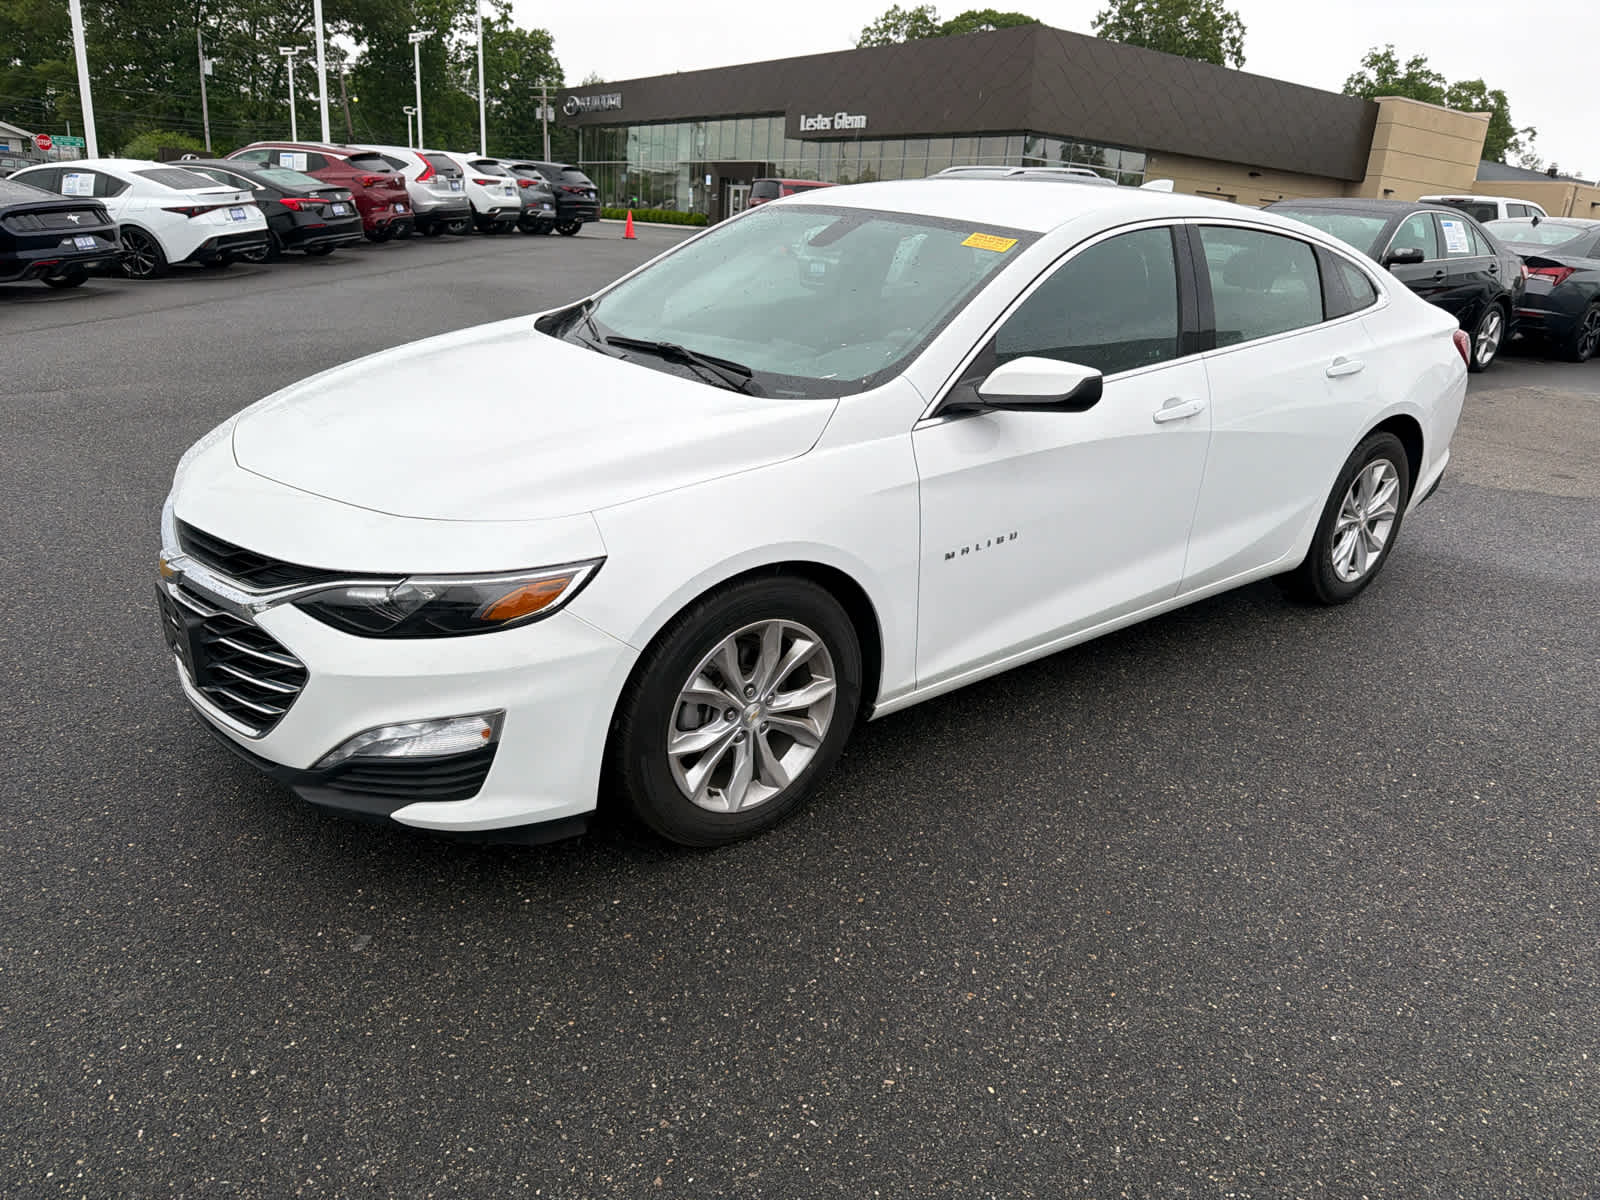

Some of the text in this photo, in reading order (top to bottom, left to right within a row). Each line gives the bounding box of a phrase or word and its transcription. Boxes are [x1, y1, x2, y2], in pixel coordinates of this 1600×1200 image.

[800, 112, 867, 131] Lester Glenn
[944, 531, 1018, 561] MALIBU
